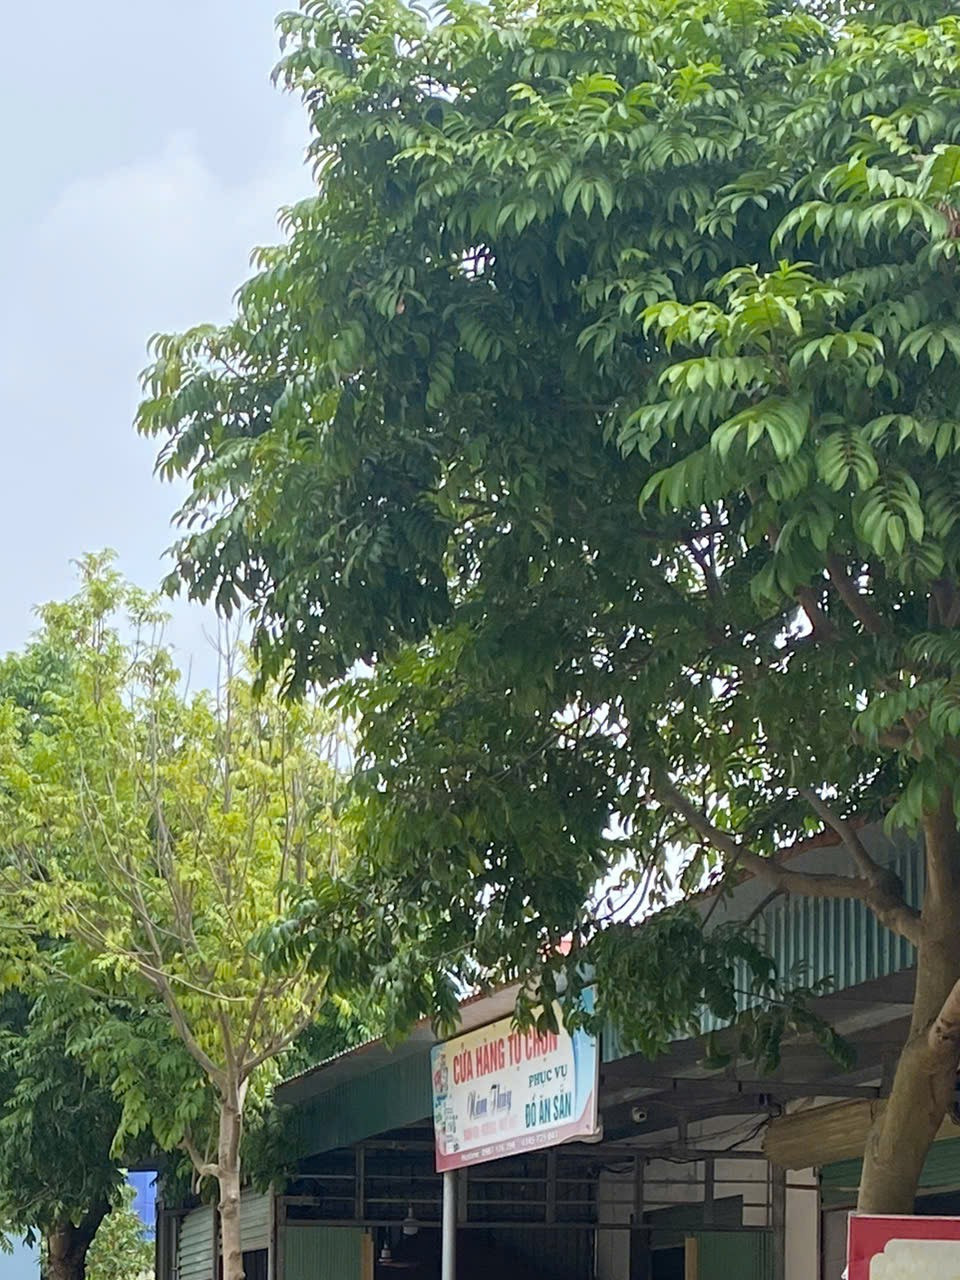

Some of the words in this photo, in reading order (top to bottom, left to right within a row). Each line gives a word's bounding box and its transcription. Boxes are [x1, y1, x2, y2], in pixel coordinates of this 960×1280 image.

[476, 1038, 505, 1078] HÀNG
[528, 1069, 552, 1088] PHỤC
[554, 1064, 568, 1081] VỤ
